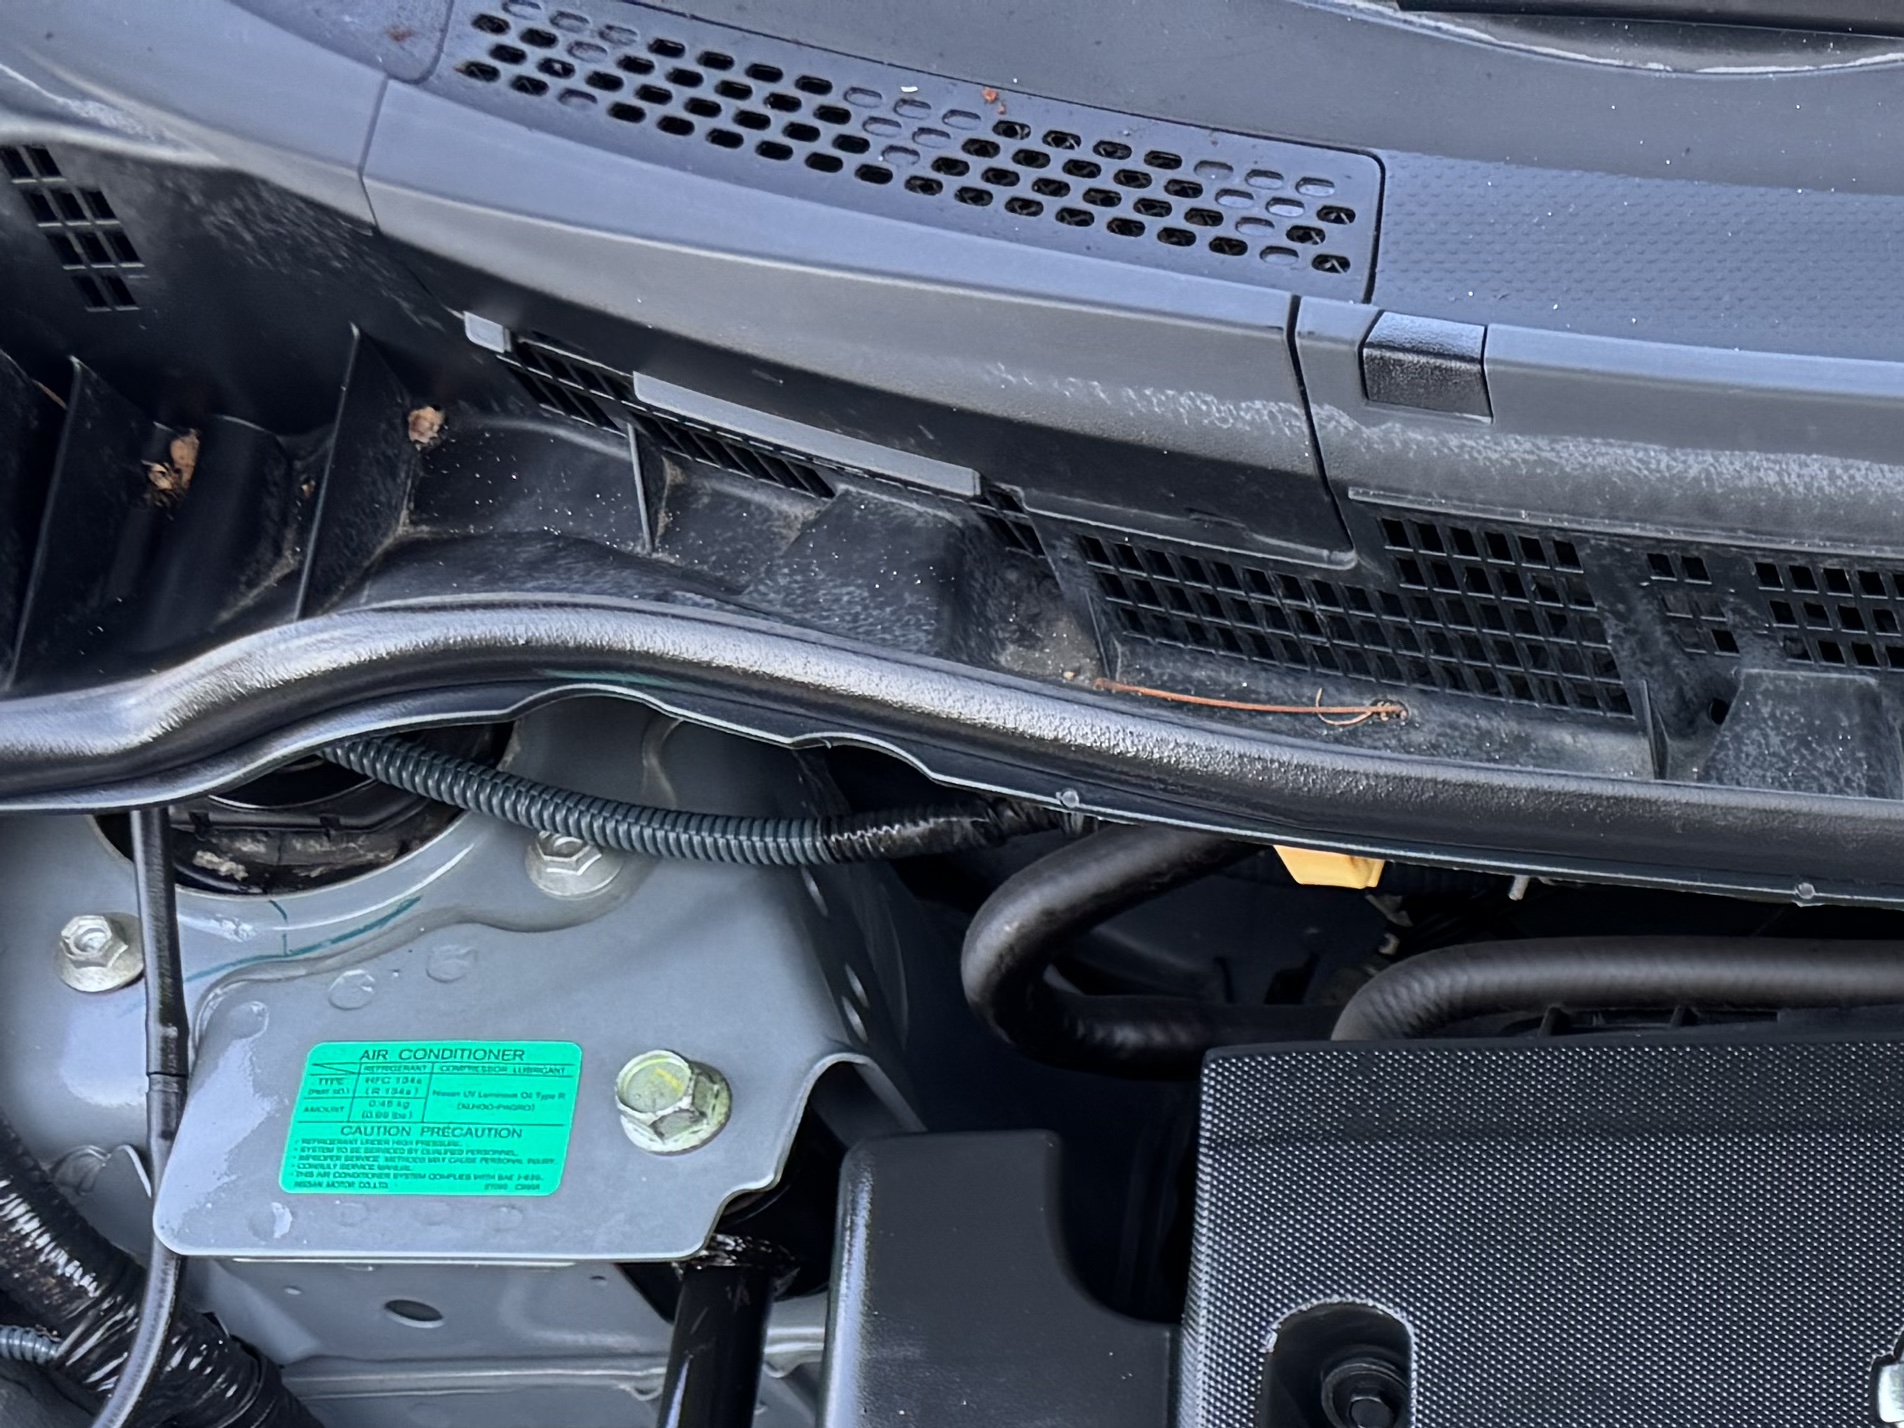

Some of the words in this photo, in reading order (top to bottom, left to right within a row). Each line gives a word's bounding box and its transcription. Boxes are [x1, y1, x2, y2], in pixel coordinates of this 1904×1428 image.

[360, 1049, 388, 1060] AIR
[398, 1048, 525, 1061] CONDITIONER
[340, 1125, 411, 1136] CAUTION
